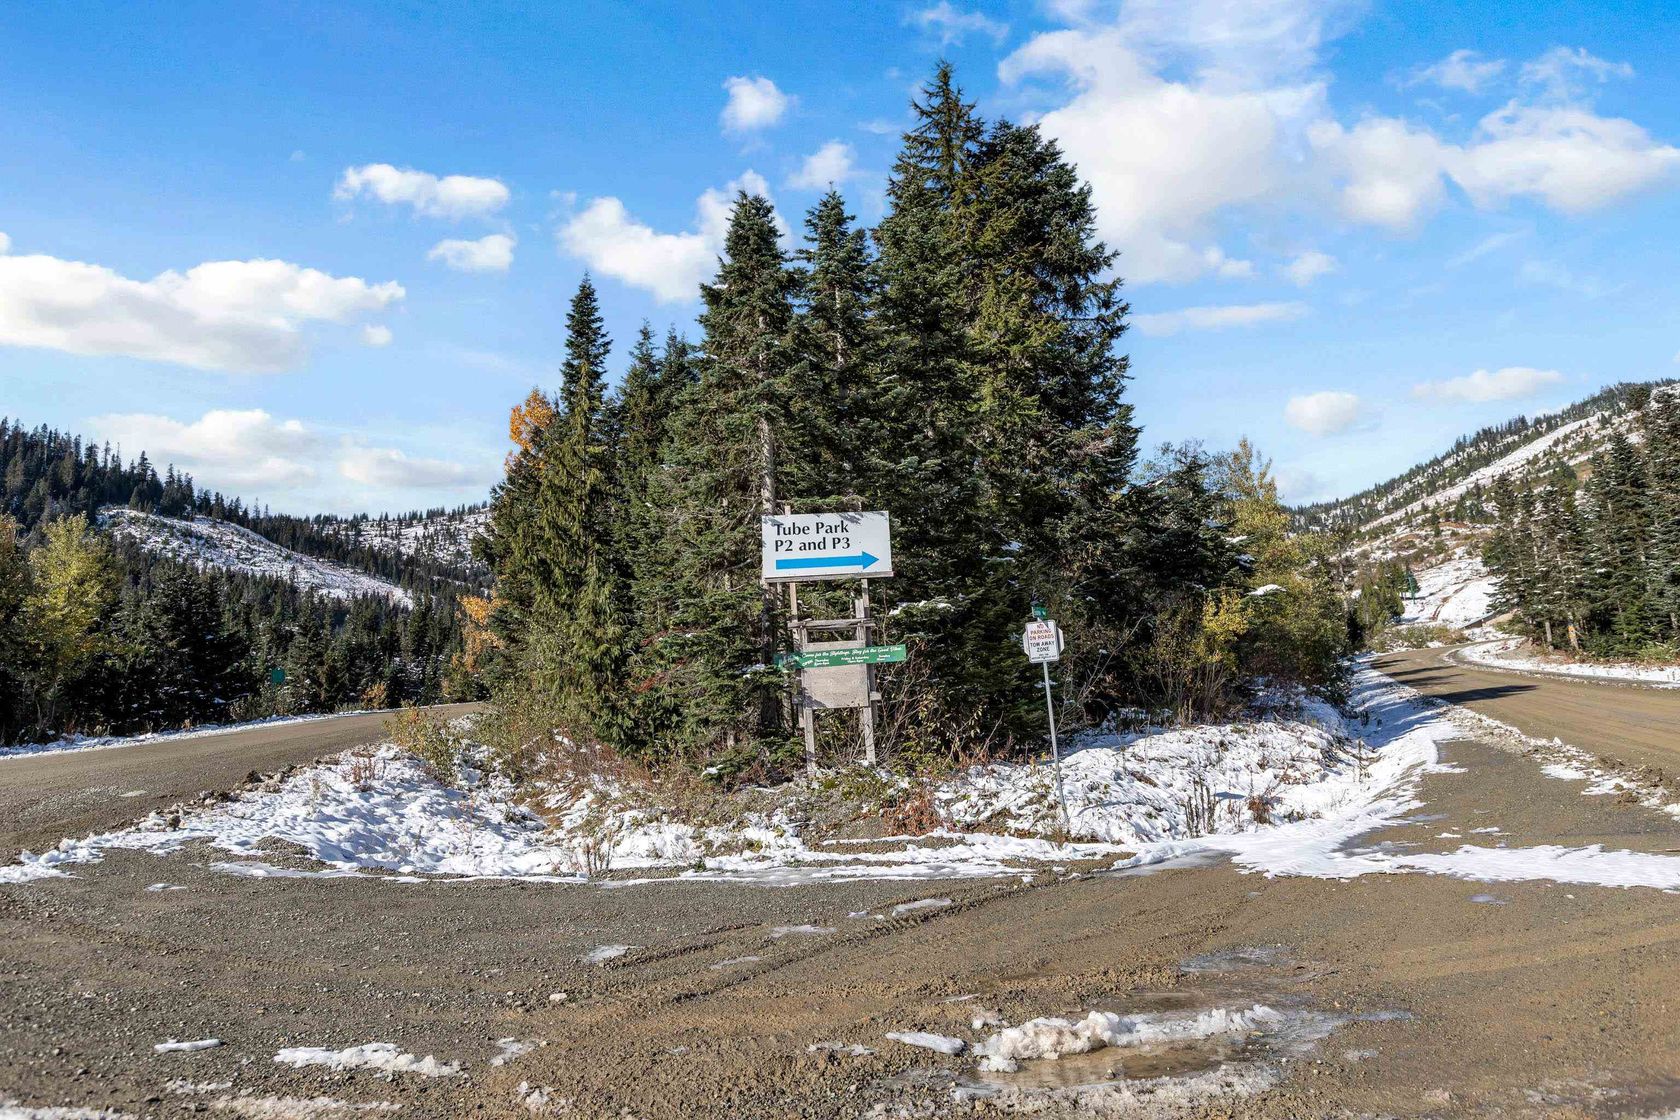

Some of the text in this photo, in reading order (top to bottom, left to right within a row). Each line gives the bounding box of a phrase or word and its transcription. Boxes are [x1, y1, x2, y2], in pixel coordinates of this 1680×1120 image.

[774, 521, 849, 536] Tube Park
[775, 537, 850, 552] P2 and P3
